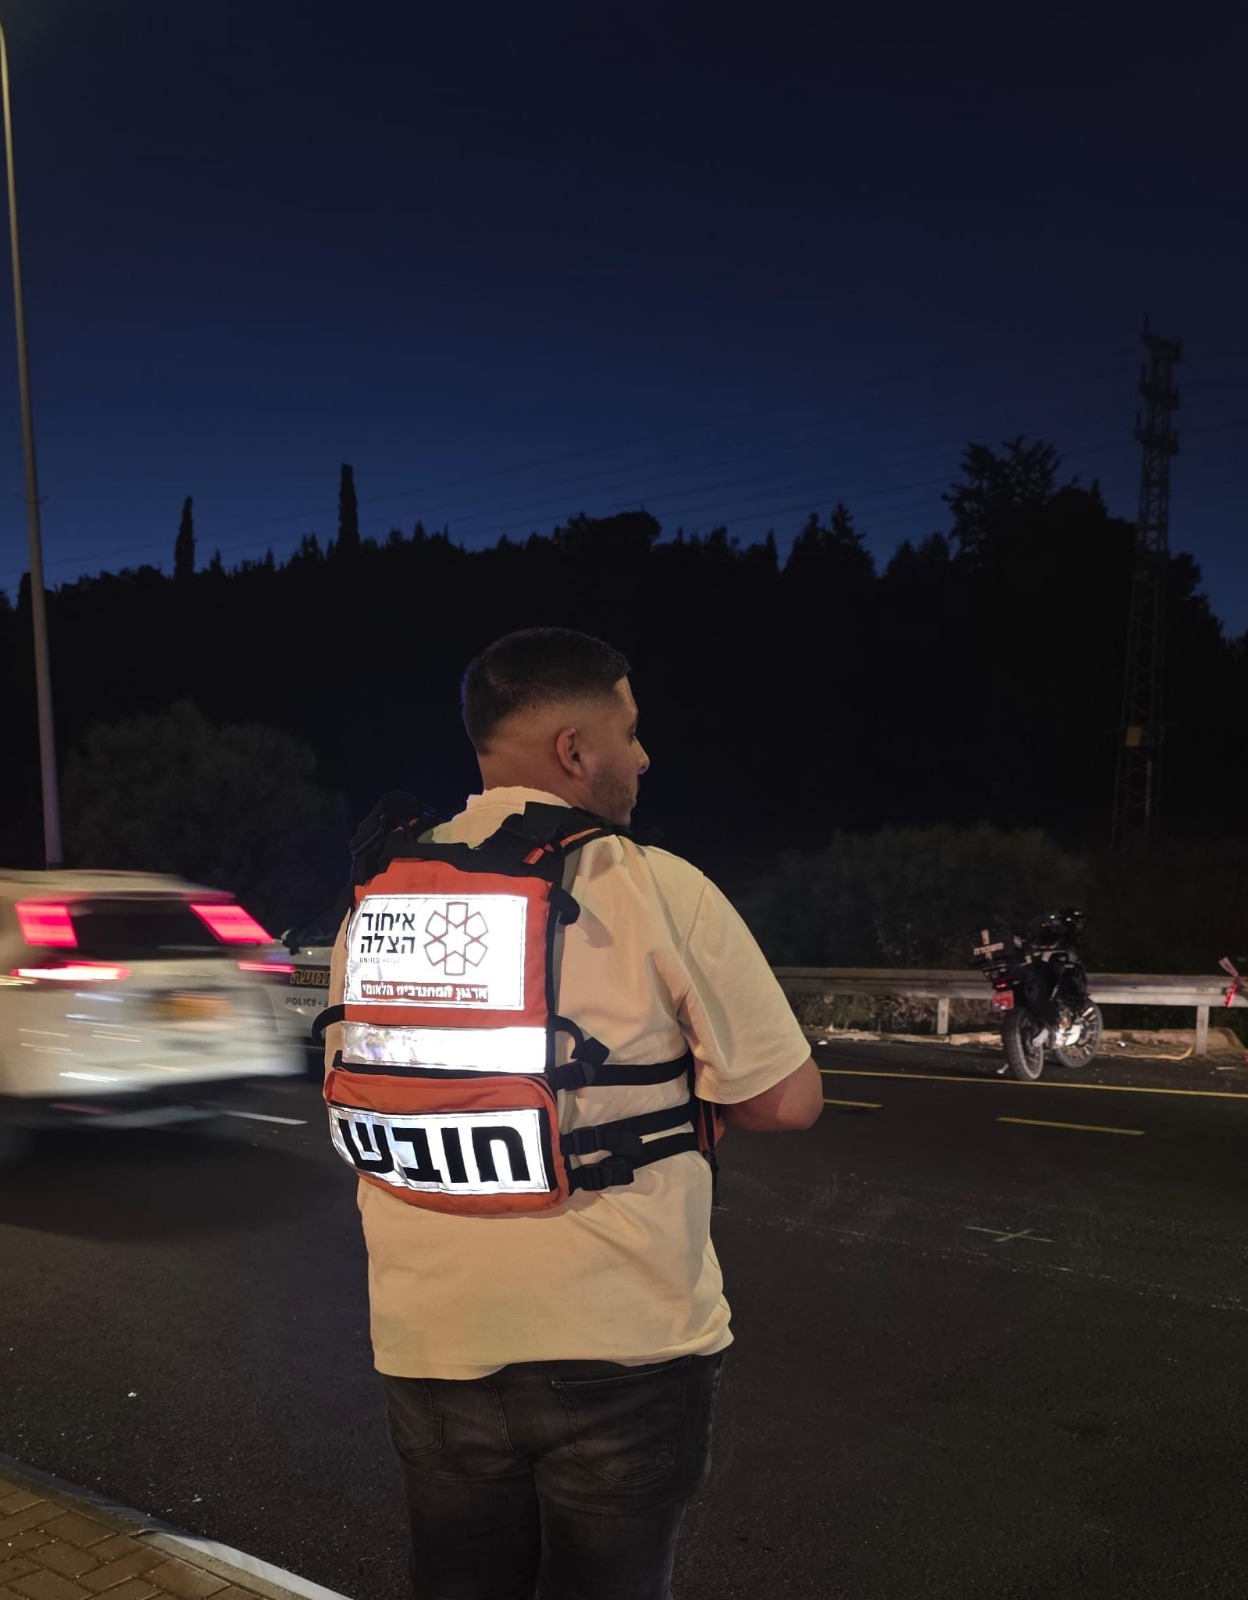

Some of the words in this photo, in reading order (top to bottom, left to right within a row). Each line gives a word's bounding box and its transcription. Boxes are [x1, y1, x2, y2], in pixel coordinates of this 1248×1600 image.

[361, 912, 415, 931] איחוד
[360, 932, 415, 954] הצלה
[286, 997, 317, 1006] POLICE
[339, 1117, 531, 1184] חובש
